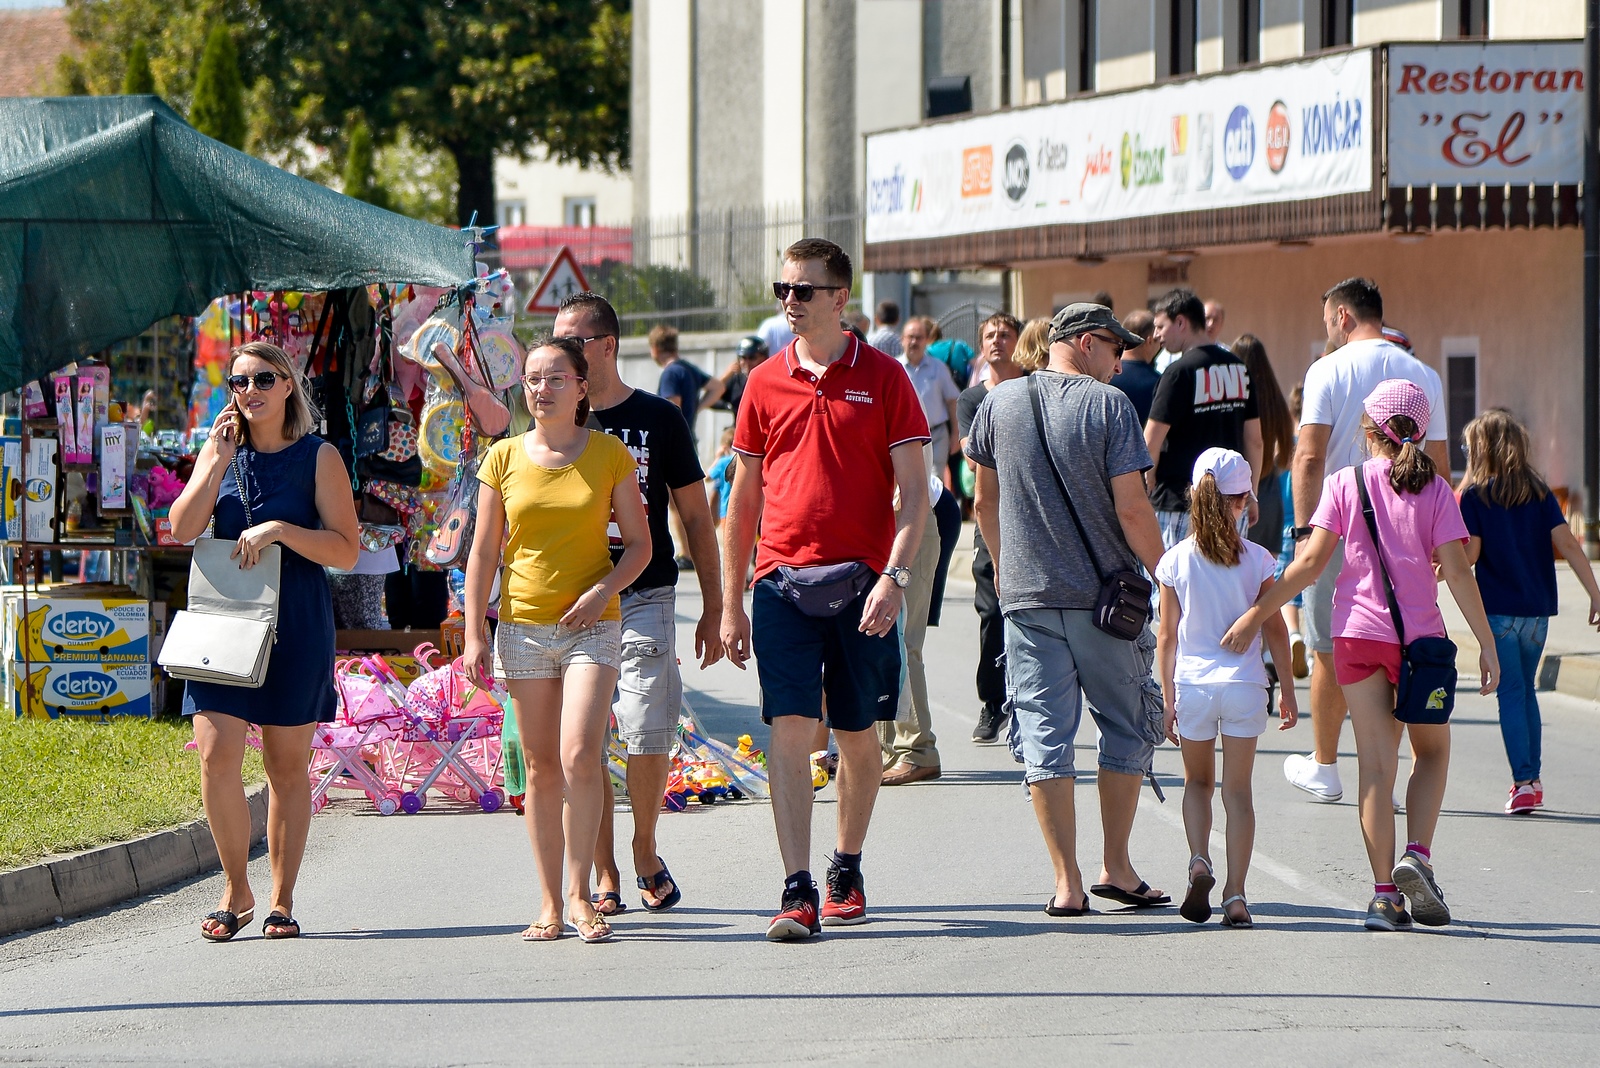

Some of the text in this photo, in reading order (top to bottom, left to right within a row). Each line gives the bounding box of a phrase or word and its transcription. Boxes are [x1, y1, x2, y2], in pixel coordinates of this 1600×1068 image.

[1397, 62, 1584, 95] Restoran
[1193, 362, 1250, 406] LOVE
[845, 394, 873, 404] ADVENTURE
[53, 612, 110, 639] derby
[53, 653, 146, 662] PREMIUM BANANAS
[57, 672, 113, 698] derby
